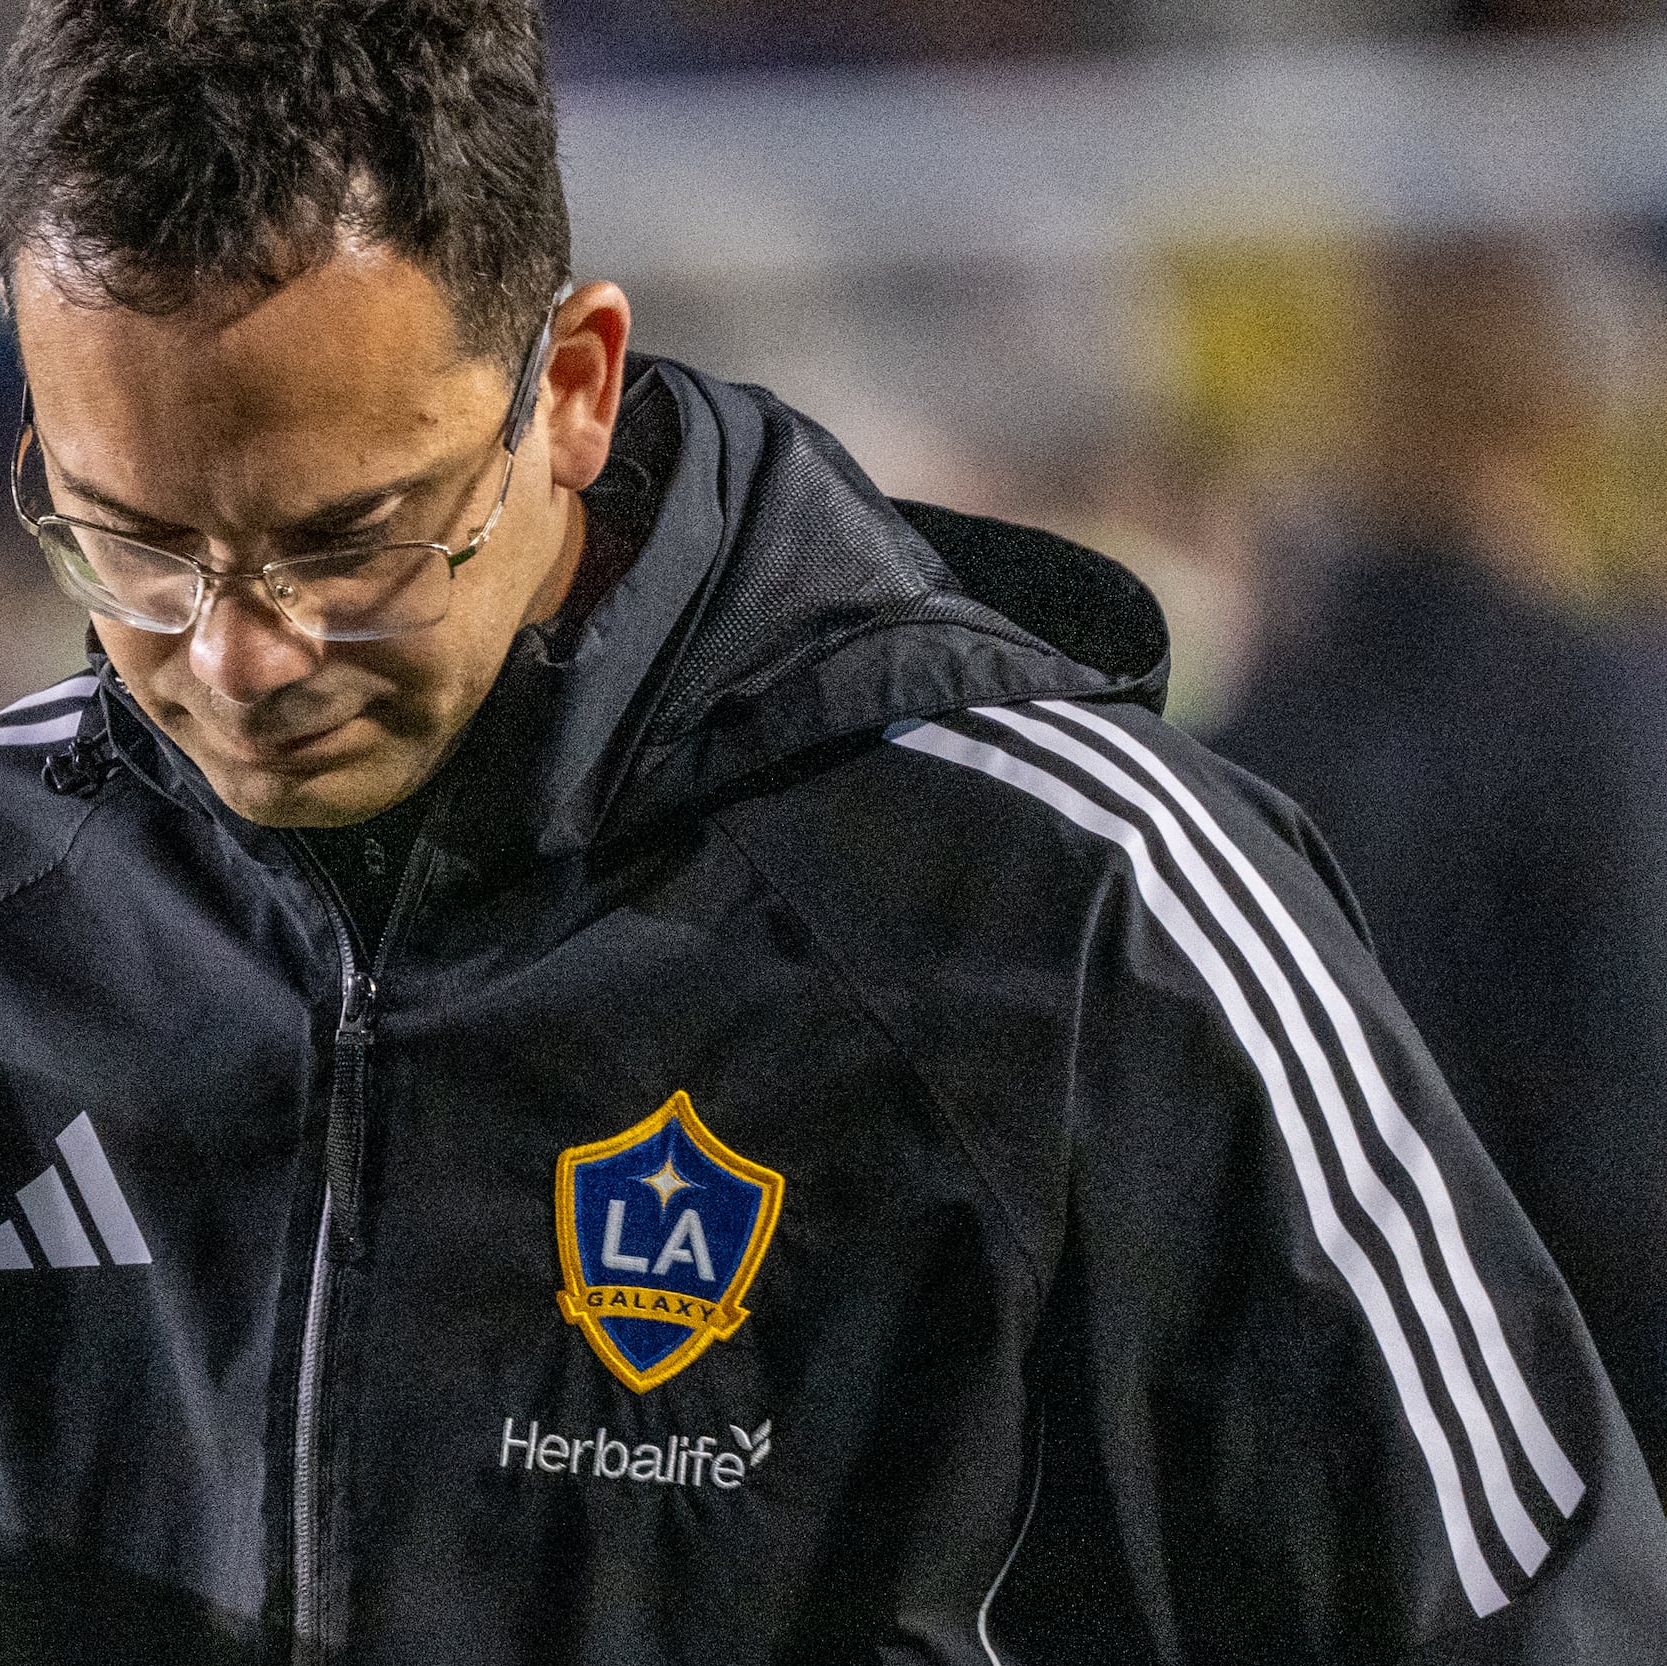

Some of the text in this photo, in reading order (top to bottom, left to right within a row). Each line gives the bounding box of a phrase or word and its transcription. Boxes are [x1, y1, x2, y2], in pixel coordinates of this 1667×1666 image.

[602, 1200, 716, 1282] LA
[586, 1289, 716, 1323] GALAXY
[499, 1417, 746, 1489] Herbalife
